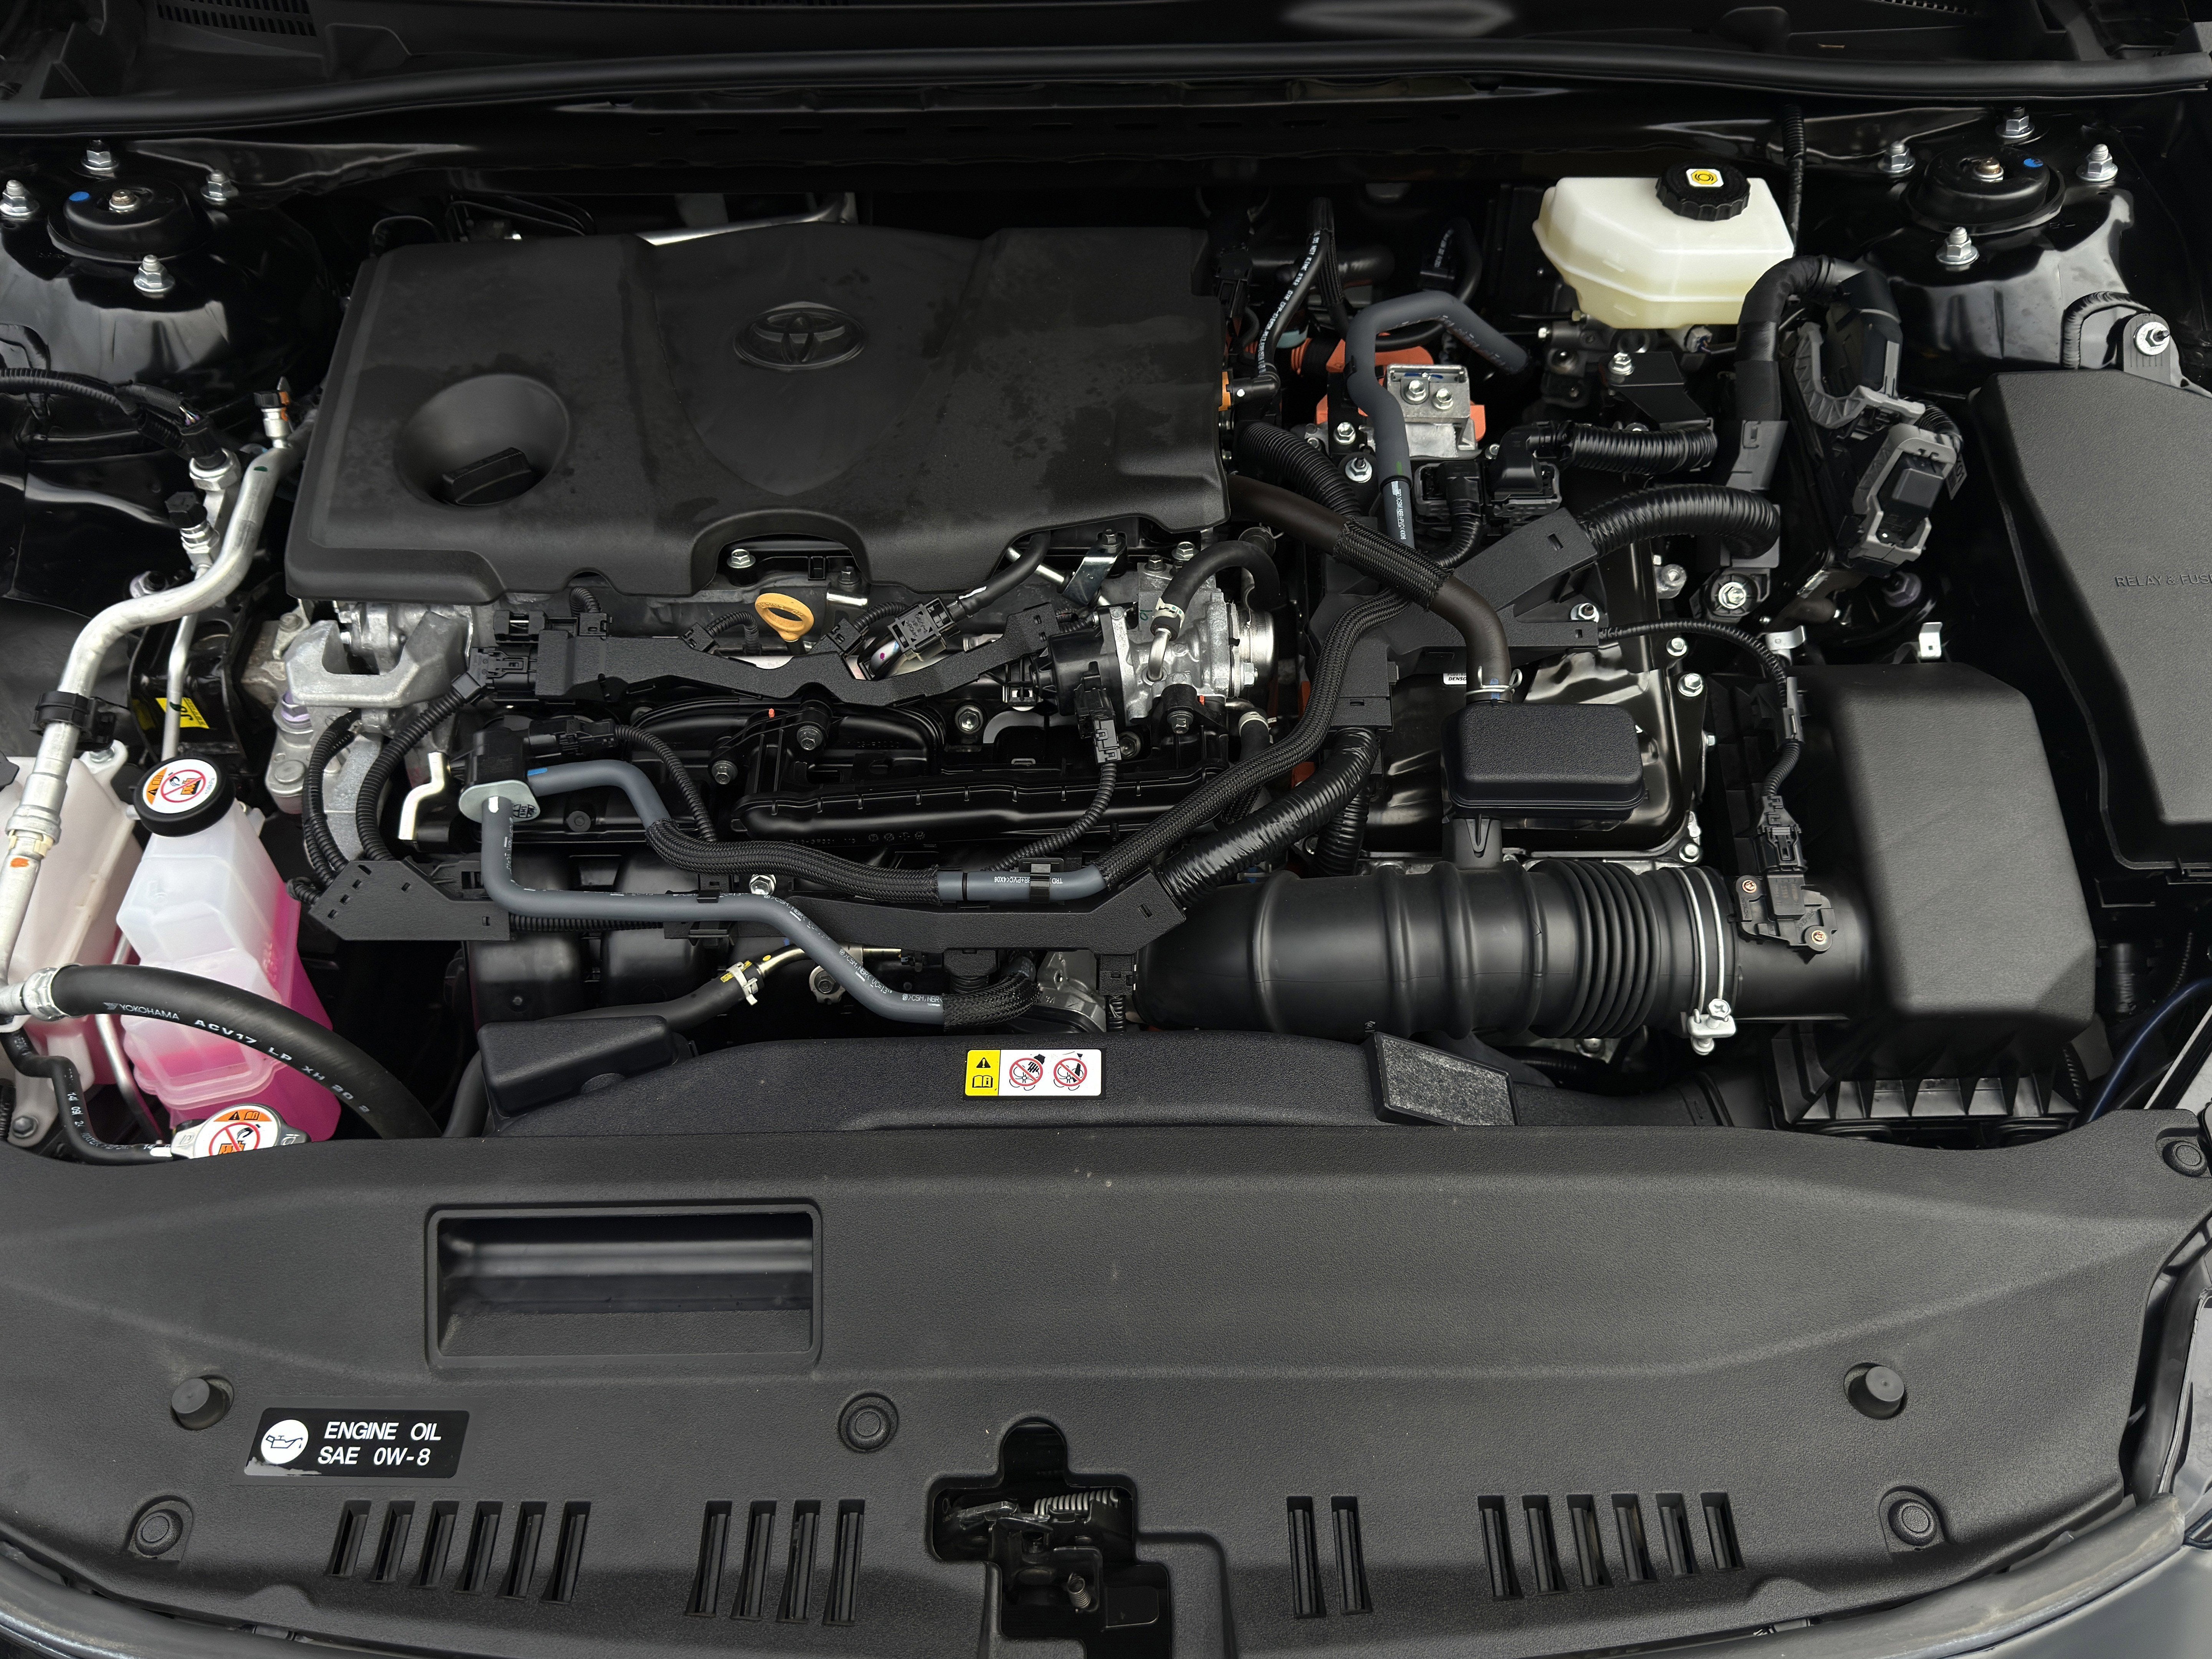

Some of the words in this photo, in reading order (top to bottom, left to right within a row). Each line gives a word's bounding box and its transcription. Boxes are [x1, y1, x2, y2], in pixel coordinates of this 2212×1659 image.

[2114, 576, 2162, 586] RELAY
[2166, 576, 2175, 585] &
[118, 1003, 180, 1021] YOKOHAMA
[194, 1019, 257, 1044] ACV17
[268, 1046, 292, 1061] LP
[301, 1065, 326, 1081] XH
[331, 1084, 354, 1100] 20
[324, 1421, 399, 1440] ENGINE
[410, 1422, 442, 1441] OIL
[318, 1445, 361, 1465] SAE
[373, 1447, 431, 1466] 0W-8
